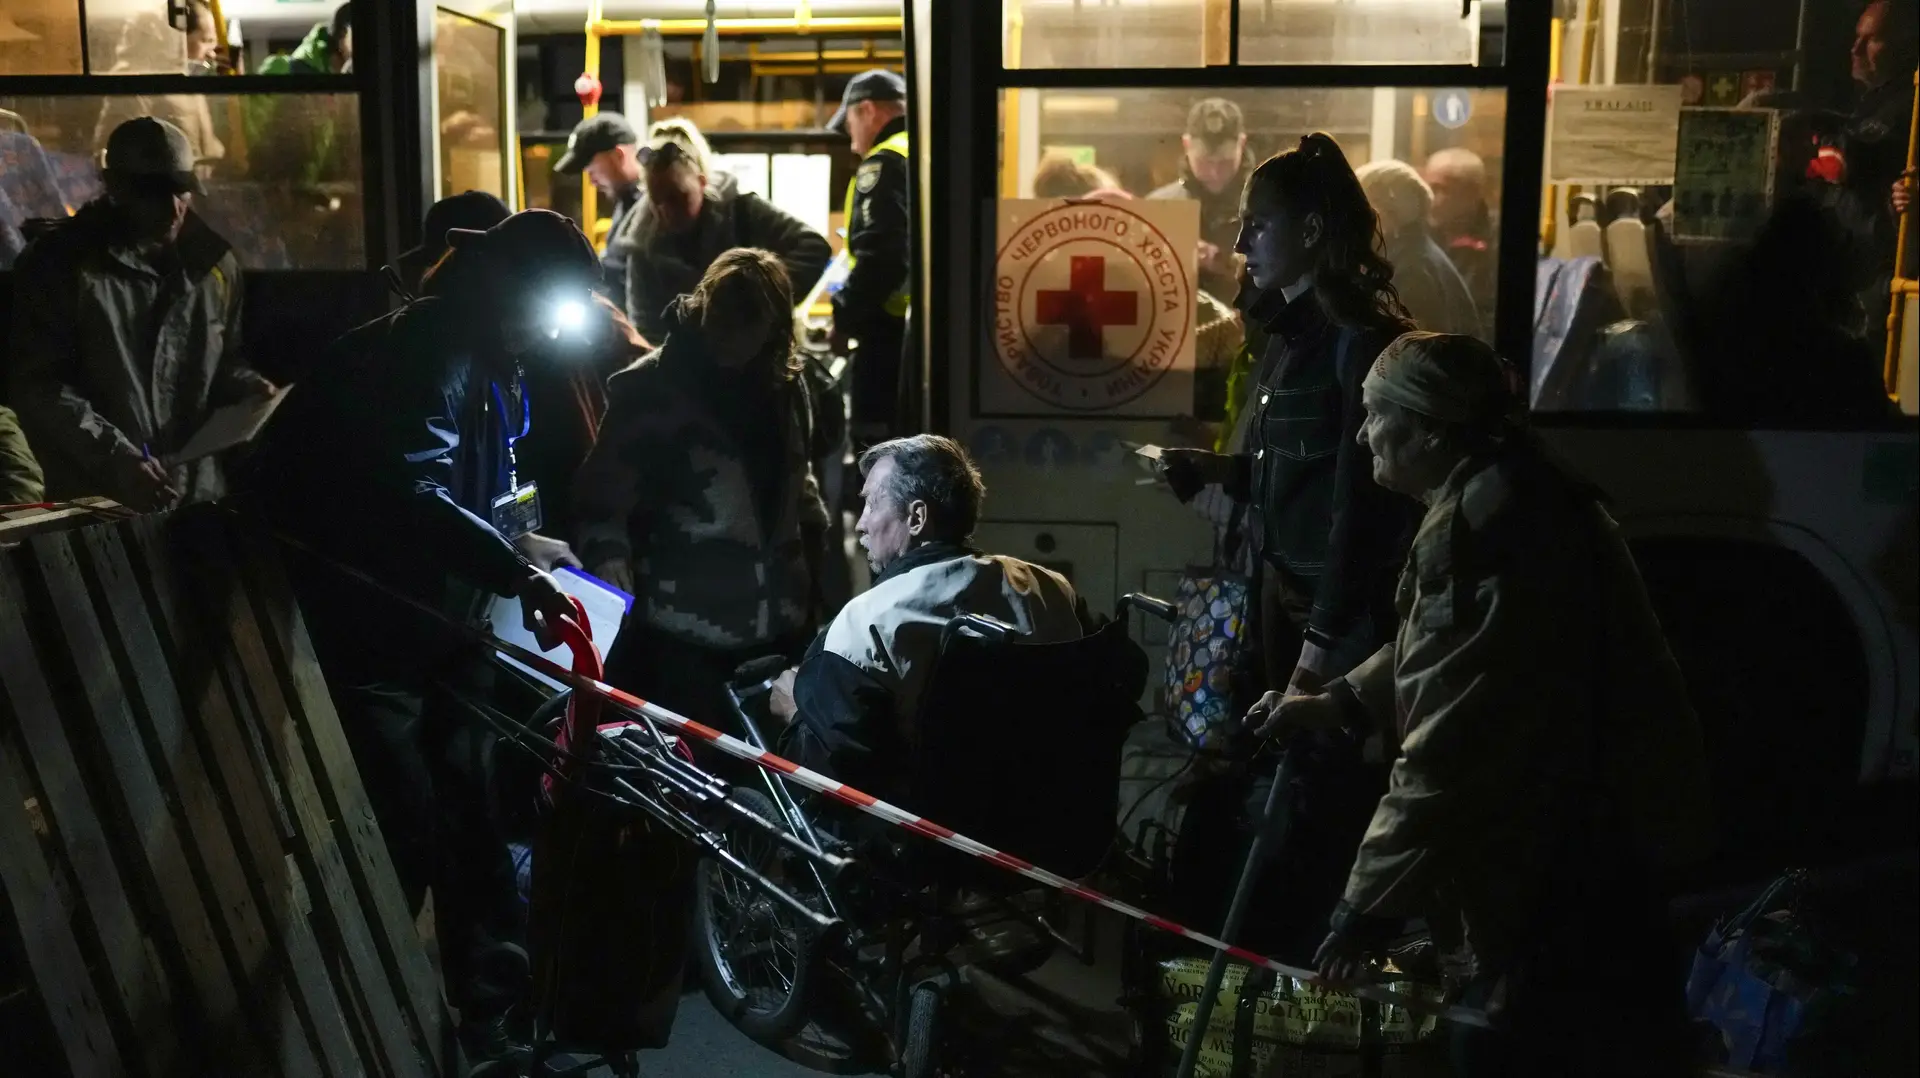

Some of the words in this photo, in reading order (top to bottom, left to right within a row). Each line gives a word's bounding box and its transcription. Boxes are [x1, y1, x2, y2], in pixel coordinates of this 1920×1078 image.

[1011, 213, 1128, 262] ЧЕРВОНОГО
[1136, 236, 1179, 313] ХРЕСТА
[995, 275, 1063, 398] ТОВАРИСТВО
[1106, 328, 1176, 398] УКРАЇНИ
